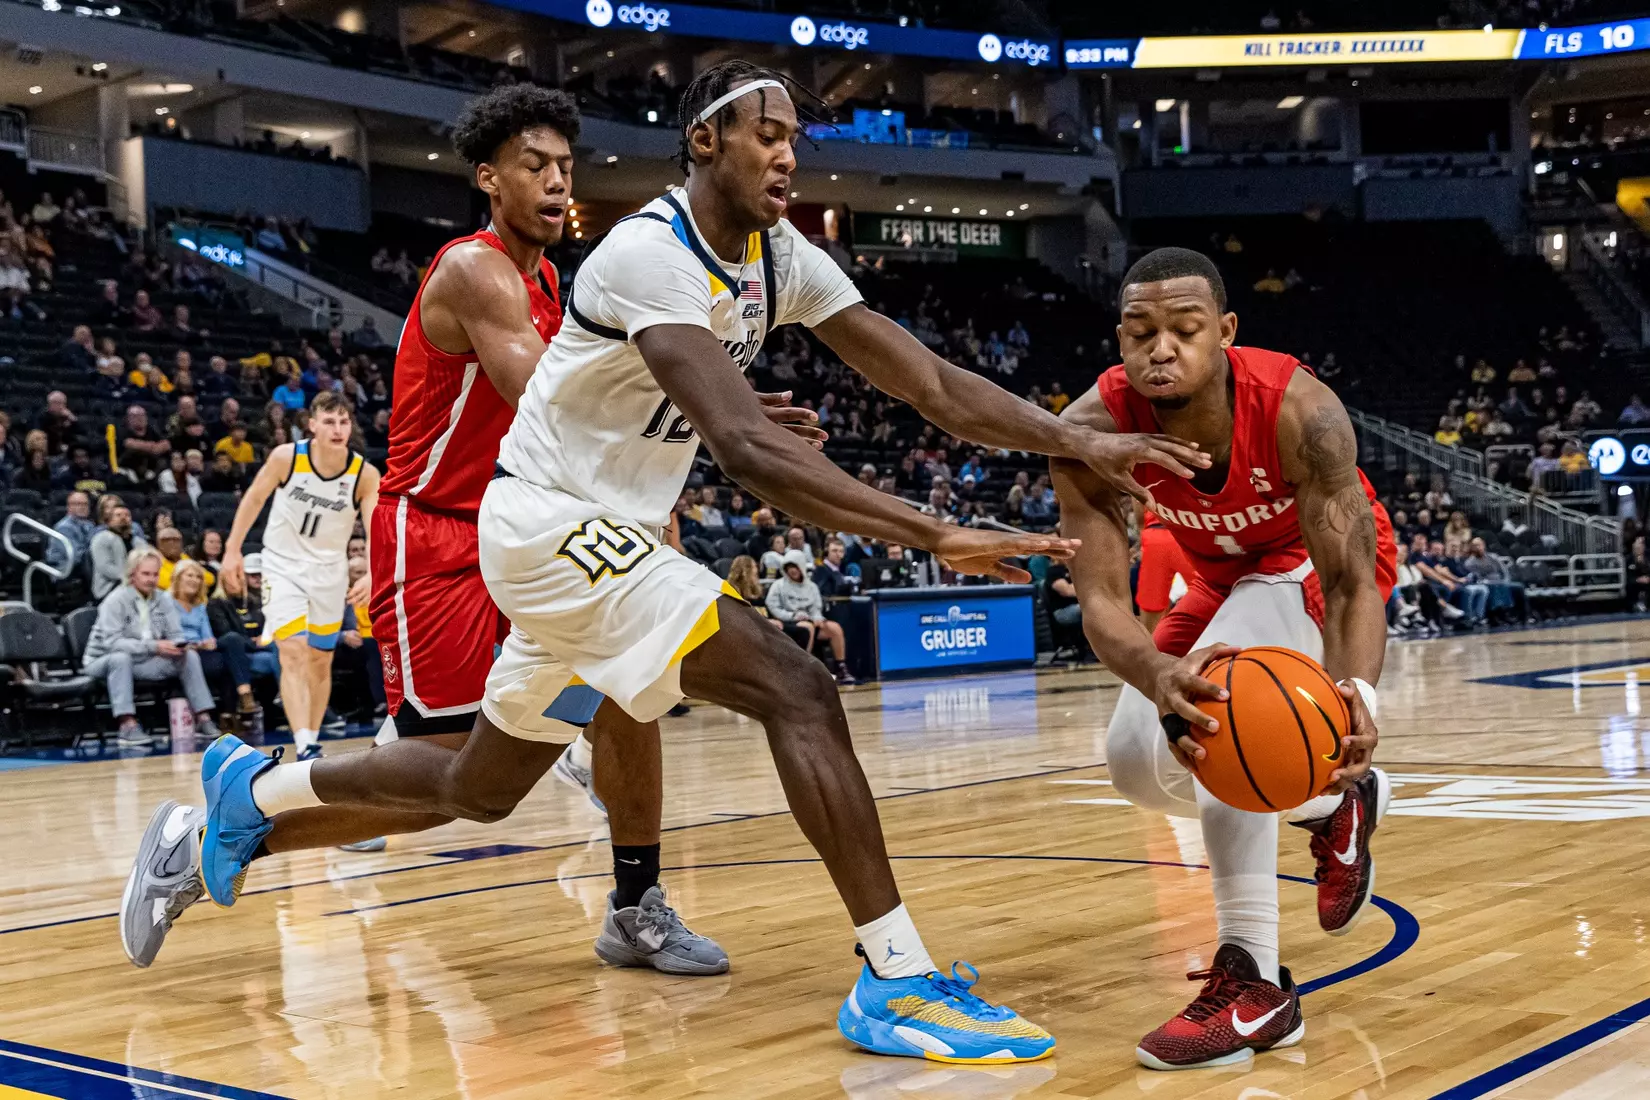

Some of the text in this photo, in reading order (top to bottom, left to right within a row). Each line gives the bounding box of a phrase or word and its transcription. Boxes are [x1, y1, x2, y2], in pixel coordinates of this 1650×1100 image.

[617, 2, 671, 32] edge
[820, 21, 869, 50] edge
[1544, 24, 1635, 54] FLS 10
[1005, 39, 1050, 66] edge
[1103, 47, 1129, 62] PM
[880, 218, 1001, 246] FEAR THE DEER
[742, 309, 765, 320] EAST
[744, 303, 760, 311] BIG
[288, 486, 348, 512] Marquette
[299, 511, 323, 538] 11
[1156, 497, 1295, 533] ADFORD
[555, 519, 655, 585] MU
[1214, 534, 1247, 555] 1
[921, 626, 988, 651] GRUBER
